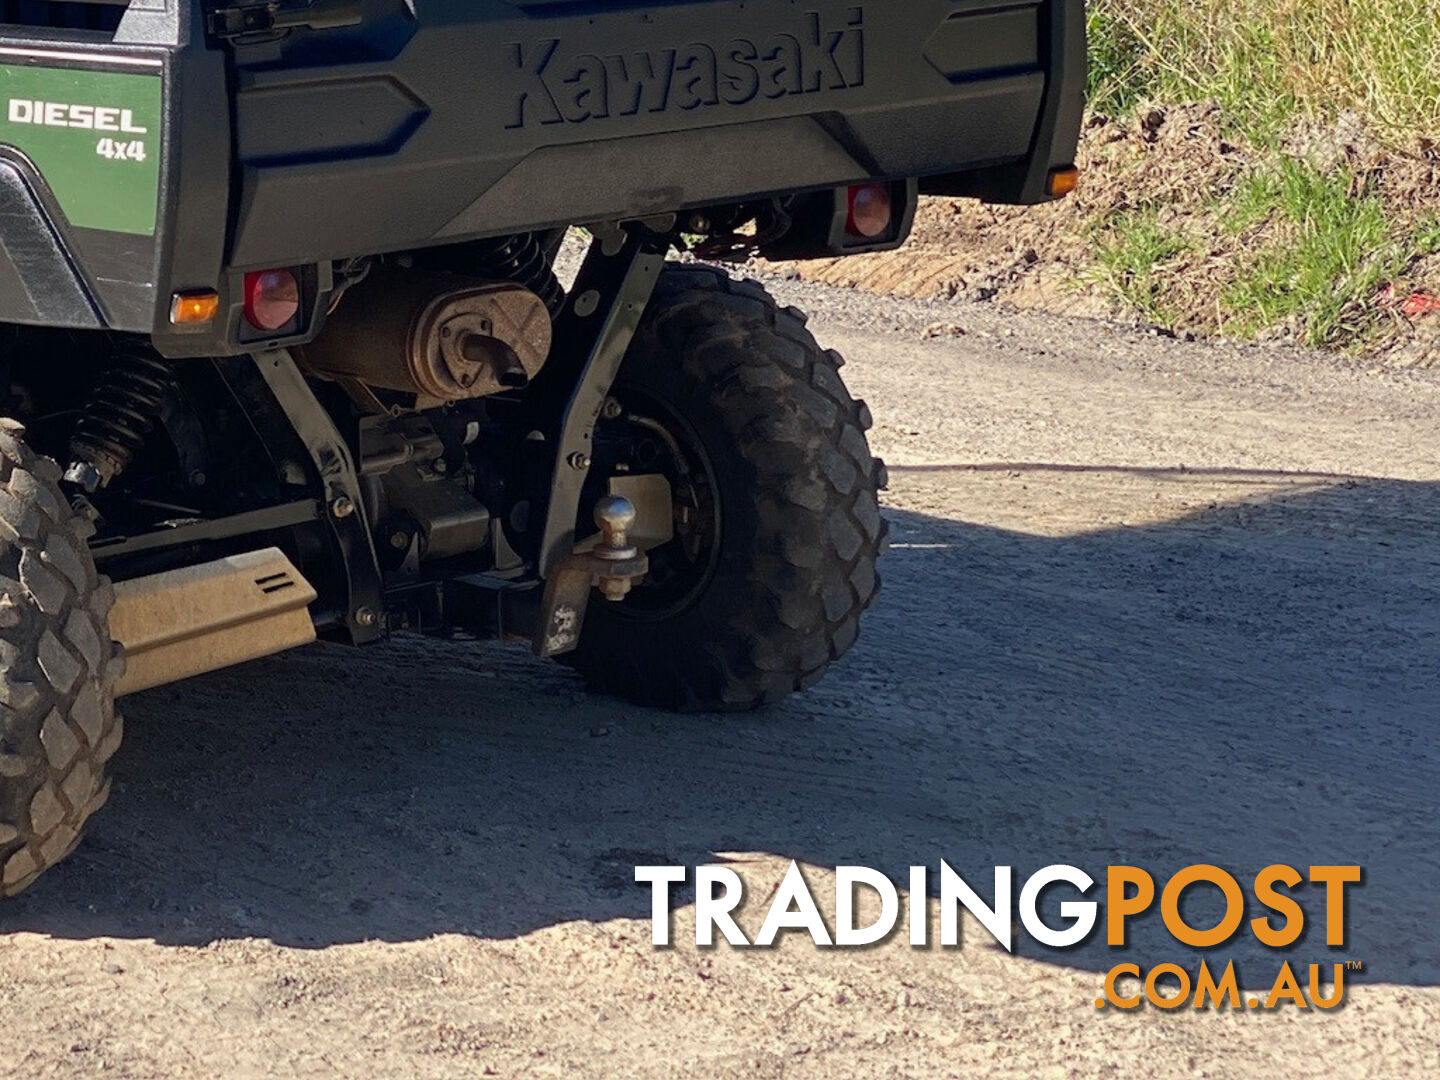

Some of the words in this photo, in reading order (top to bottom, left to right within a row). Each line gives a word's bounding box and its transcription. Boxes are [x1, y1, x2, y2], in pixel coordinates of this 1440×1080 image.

[503, 6, 864, 130] Kawasaki
[8, 98, 147, 134] DIESEL
[96, 137, 147, 162] 4x4
